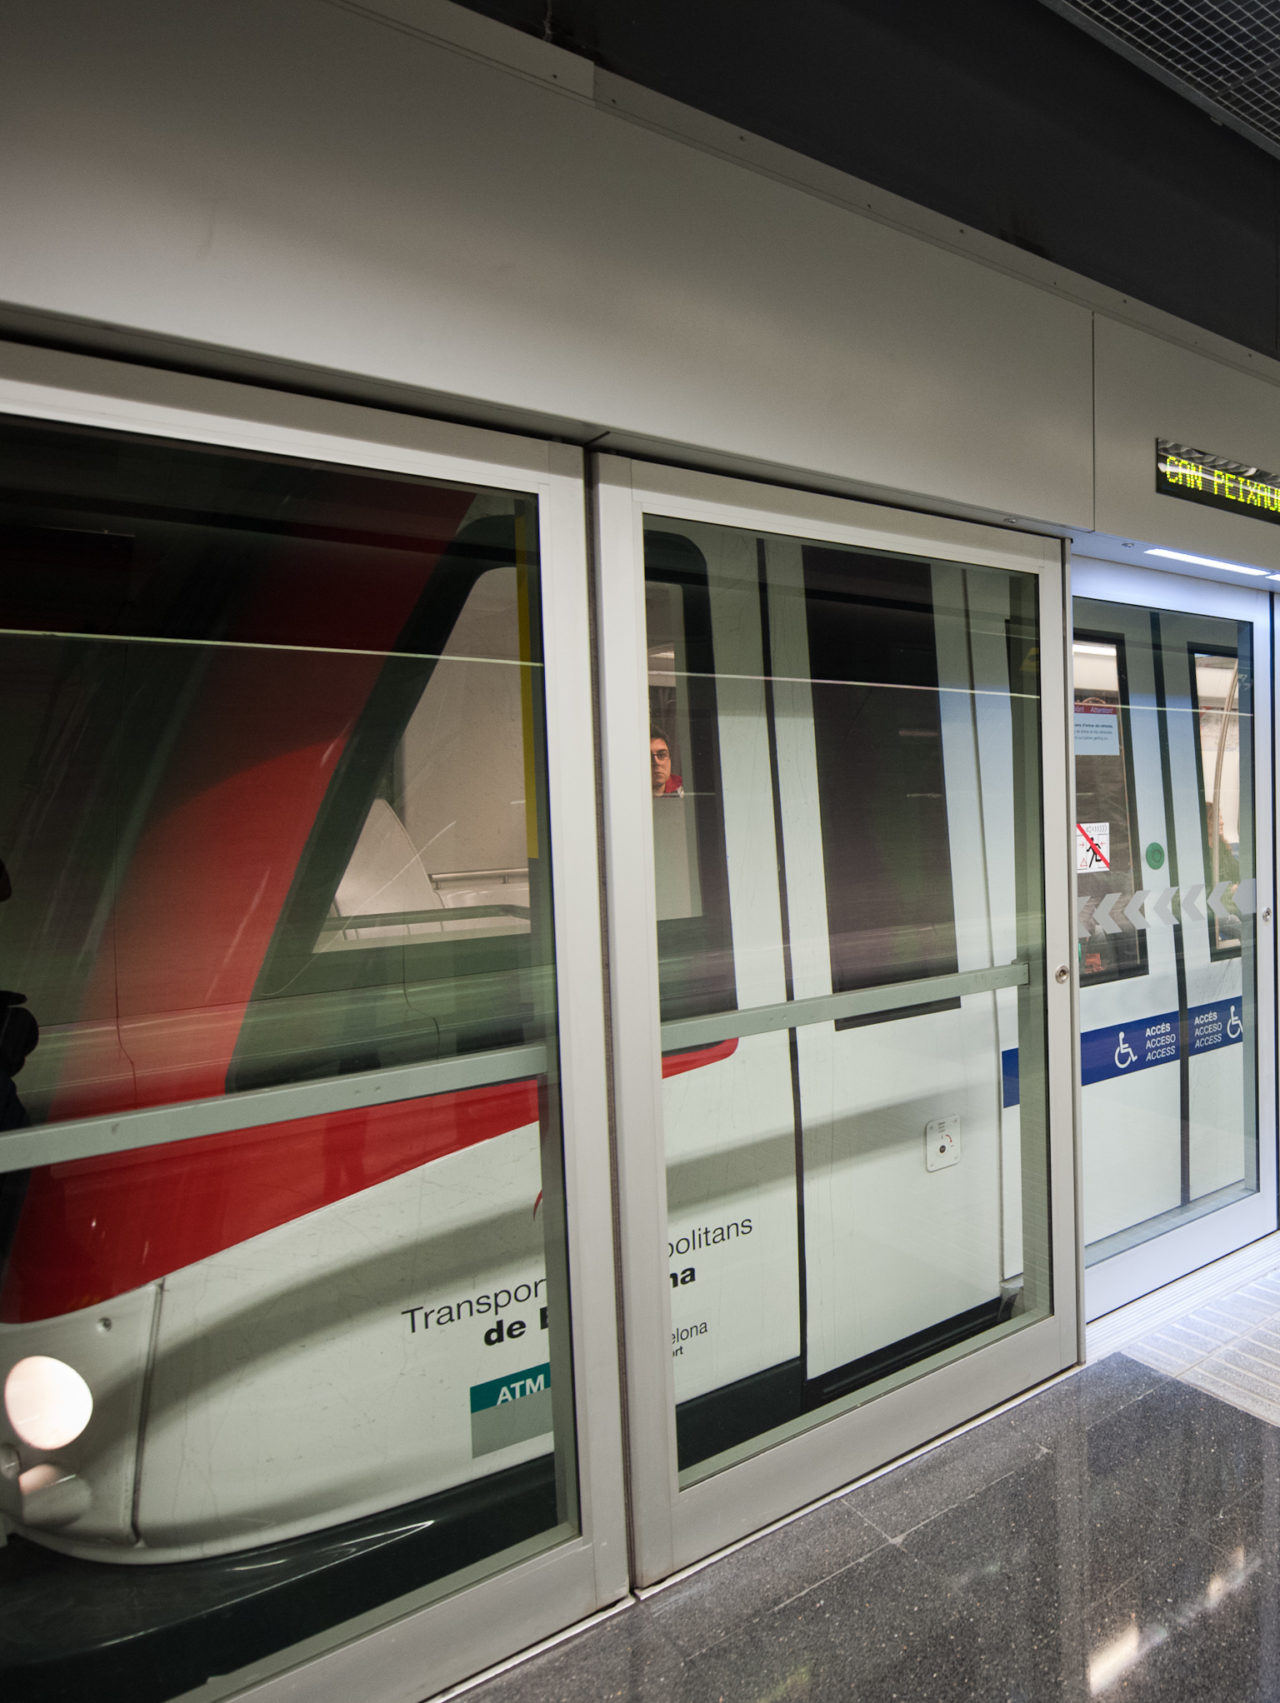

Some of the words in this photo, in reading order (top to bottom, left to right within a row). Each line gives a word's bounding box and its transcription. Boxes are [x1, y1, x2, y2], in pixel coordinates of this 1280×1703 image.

[1166, 455, 1203, 491] CAN
[1145, 1022, 1171, 1037] ACCÉS
[1194, 1022, 1223, 1037] ACCESO
[1145, 1033, 1176, 1050] ACCESO
[1194, 1033, 1223, 1049] ACCESS
[1145, 1045, 1176, 1062] ACCESS
[401, 1278, 547, 1334] Transpor
[484, 1319, 527, 1347] de
[497, 1373, 545, 1406] ATM
